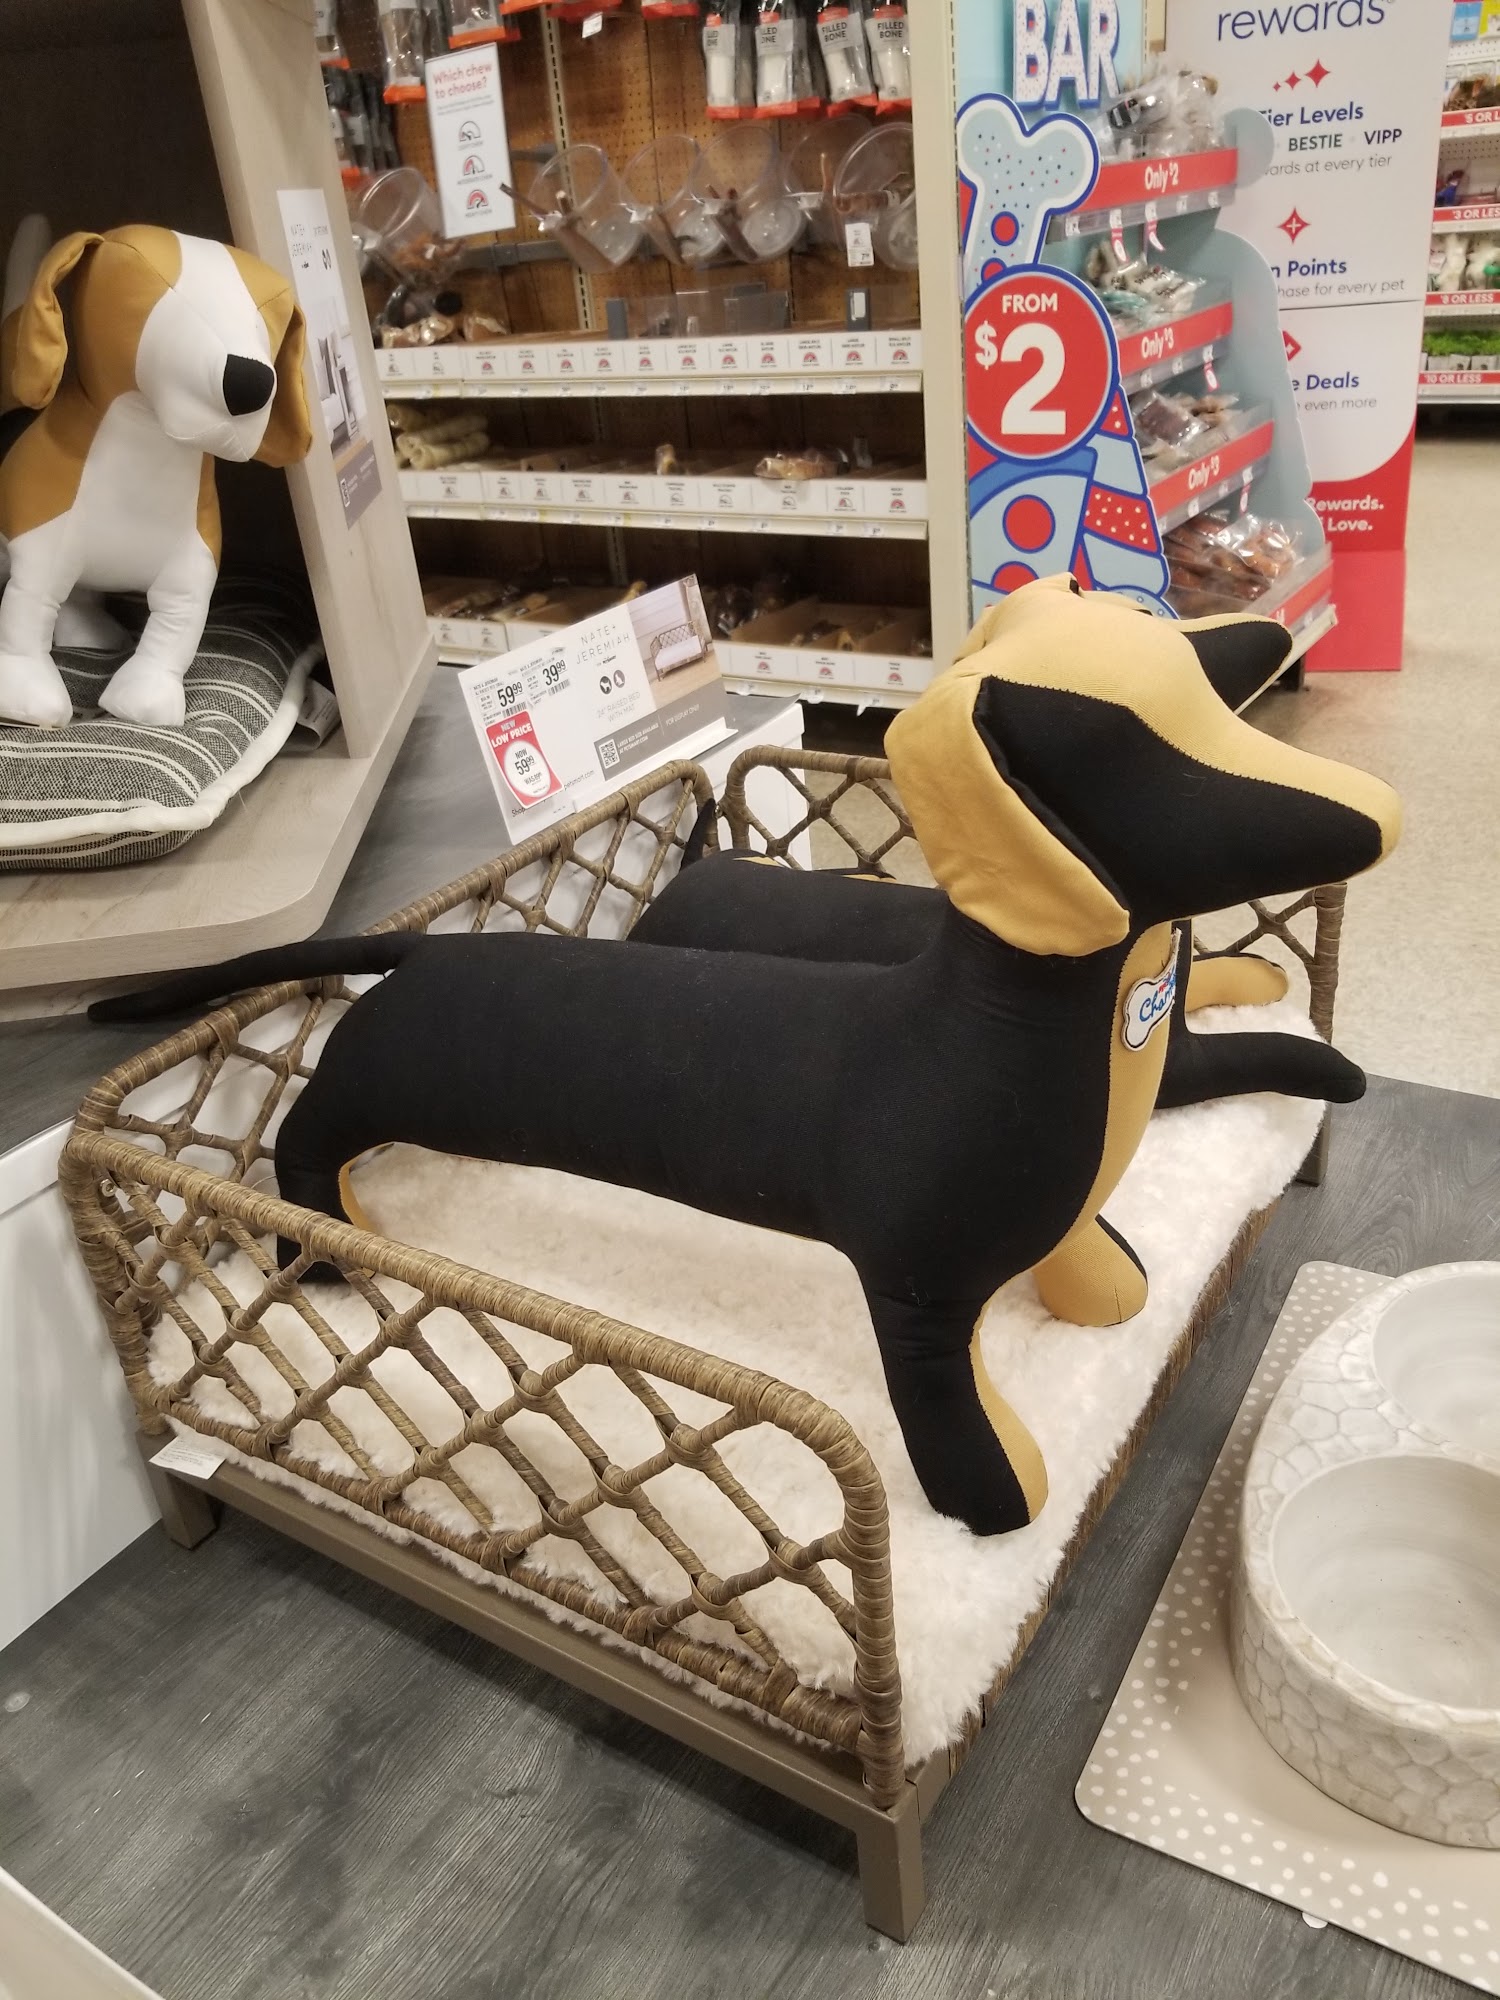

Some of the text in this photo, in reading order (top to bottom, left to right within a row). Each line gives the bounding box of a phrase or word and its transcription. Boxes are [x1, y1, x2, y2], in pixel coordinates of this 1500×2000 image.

[821, 22, 848, 33] FILLED
[877, 22, 904, 30] FILLED
[1218, 0, 1385, 41] rewards
[824, 30, 847, 43] BONE
[879, 30, 903, 38] BONE
[1013, 0, 1120, 110] BAR
[433, 62, 492, 84] Which chew
[434, 76, 488, 100] to choose?
[1300, 101, 1364, 124] Levels
[1288, 128, 1402, 152] BESTIE VIPP
[1305, 160, 1319, 172] at
[1324, 156, 1364, 174] every
[1369, 153, 1392, 168] tier
[1145, 163, 1168, 193] Only
[1464, 209, 1480, 219] OR
[1288, 258, 1347, 277] Points
[1314, 281, 1333, 296] for
[1338, 282, 1377, 300] every
[1381, 279, 1405, 294] pet
[1451, 294, 1467, 304] OR
[1469, 293, 1494, 304] LESS
[1002, 293, 1058, 313] FROM
[1142, 331, 1164, 358] Only
[974, 320, 1066, 434] $2
[1306, 372, 1360, 390] Deals
[1439, 374, 1456, 384] OR
[1458, 373, 1482, 383] LESS
[1304, 398, 1377, 412] even more
[1188, 462, 1210, 490] Only
[1328, 518, 1374, 532] Love.
[576, 633, 630, 664] JEREMIAH
[491, 722, 533, 748] LOW PRICE
[501, 720, 516, 732] NEW
[515, 748, 528, 760] NOW
[512, 807, 526, 818] Shop
[564, 770, 594, 792] petsmart.com
